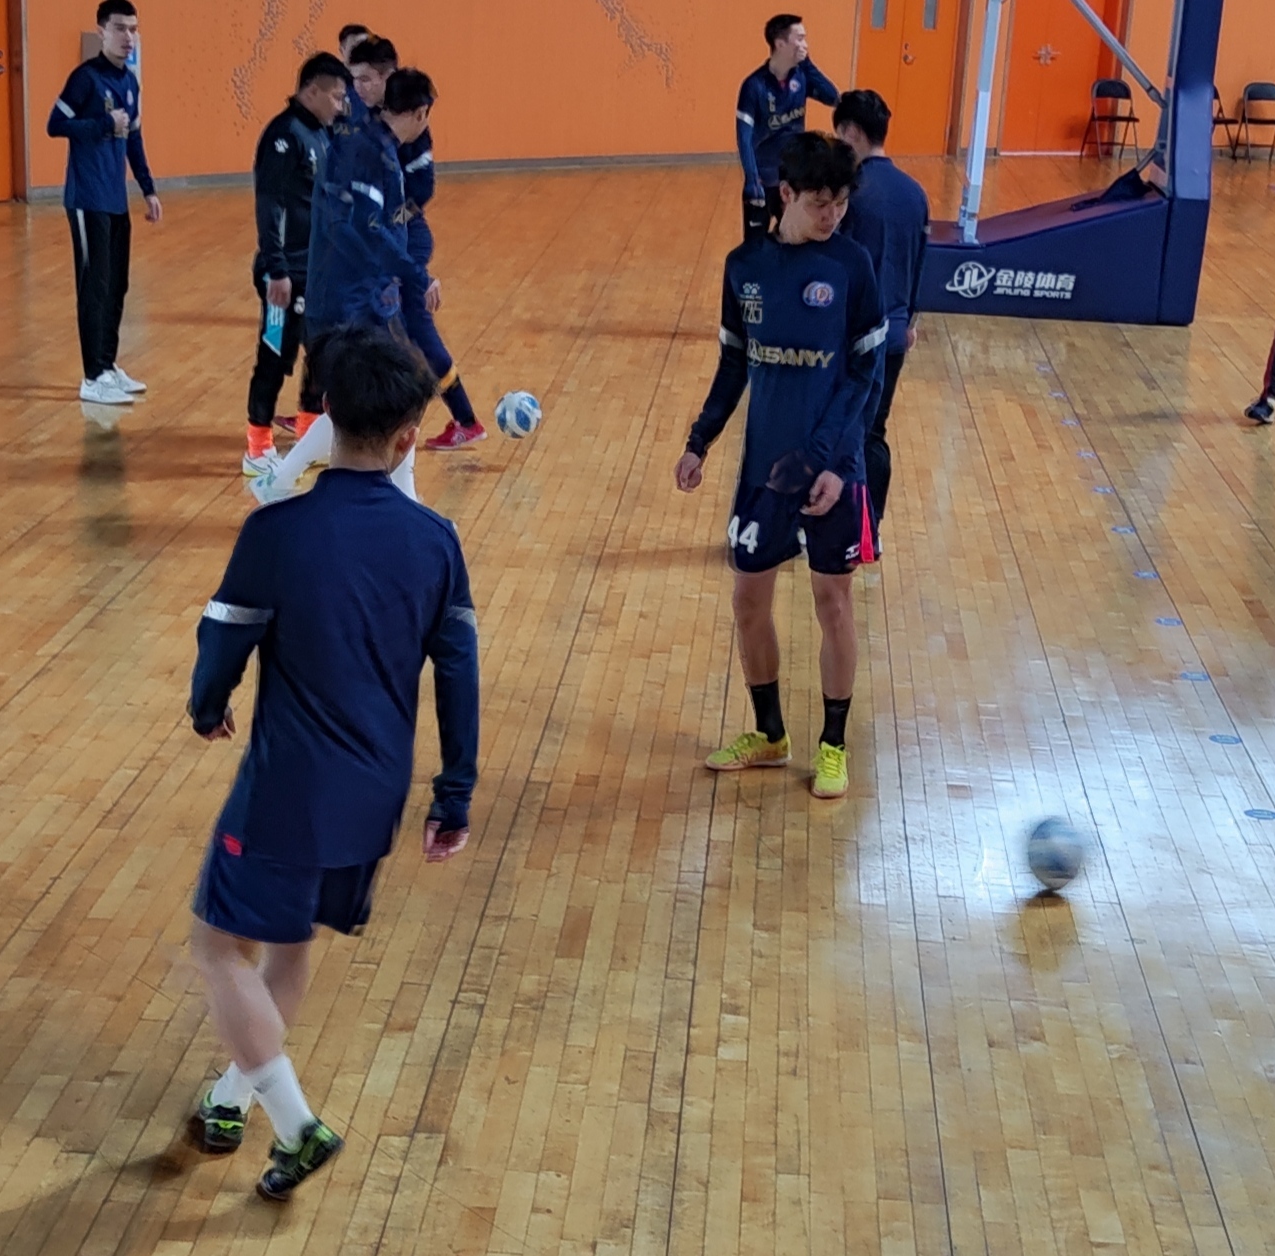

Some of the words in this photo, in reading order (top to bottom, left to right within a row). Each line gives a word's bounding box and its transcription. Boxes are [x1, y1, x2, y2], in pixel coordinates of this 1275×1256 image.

[994, 269, 1076, 291] 金陵体育
[993, 287, 1031, 297] JINLING
[1033, 290, 1072, 299] SPORTS
